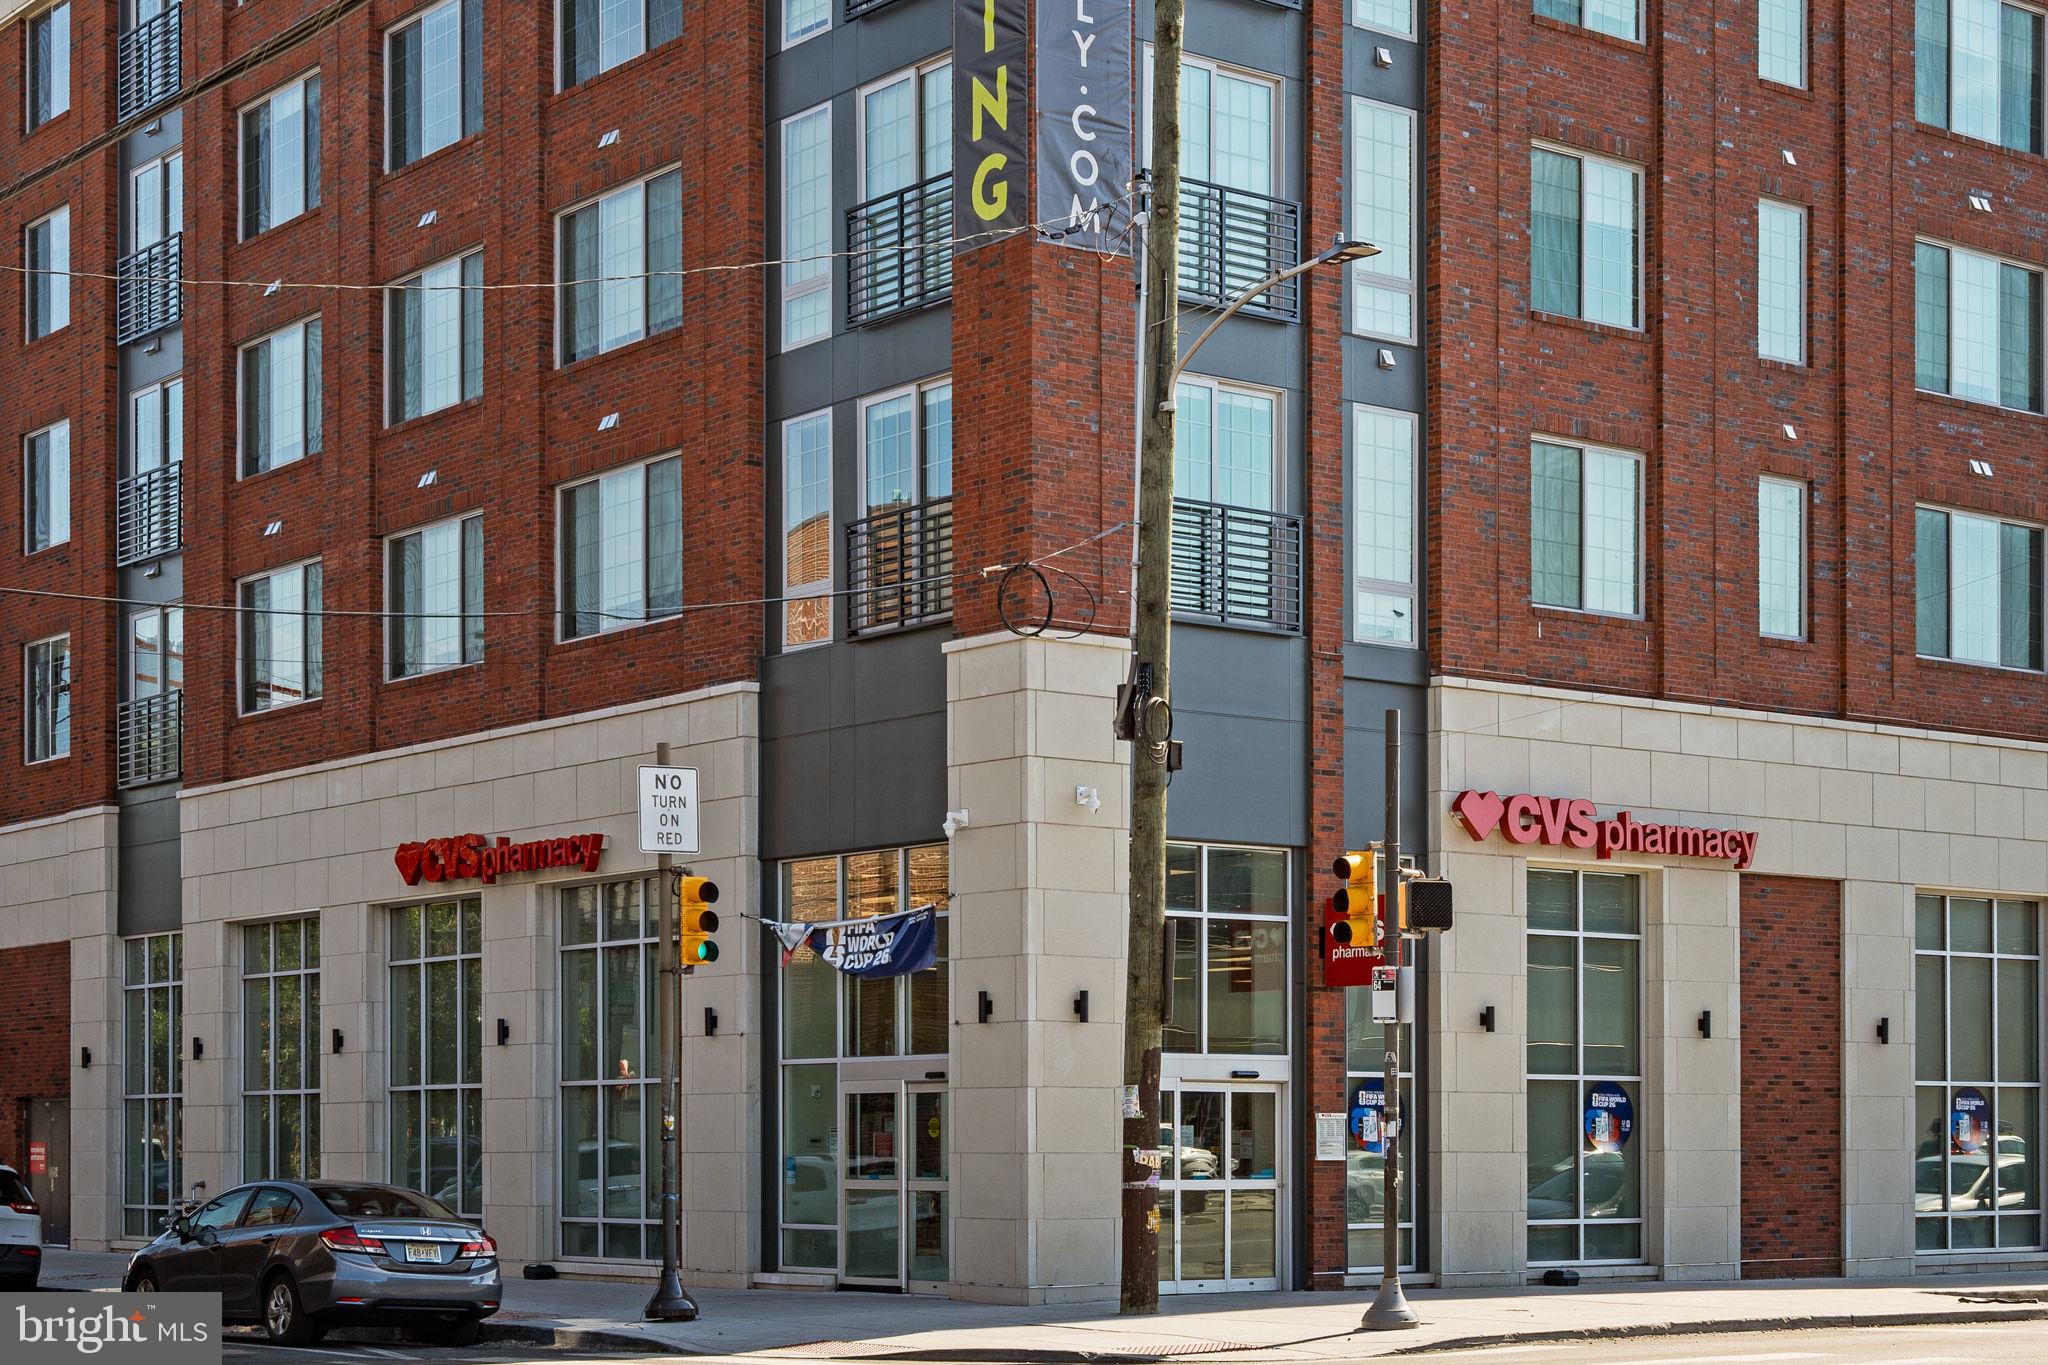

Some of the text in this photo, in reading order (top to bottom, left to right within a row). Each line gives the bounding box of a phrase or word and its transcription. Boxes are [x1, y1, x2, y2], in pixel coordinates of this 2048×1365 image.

[655, 774, 682, 790] NO
[652, 795, 687, 808] TURN
[660, 813, 679, 827] ON
[657, 832, 682, 846] RED
[1499, 793, 1759, 870] CVS pharmacy
[421, 833, 604, 885] CVS pharmacy
[847, 923, 875, 934] FIFA
[847, 931, 895, 953] WORLD
[843, 952, 874, 970] CUP
[1373, 980, 1382, 991] 64
